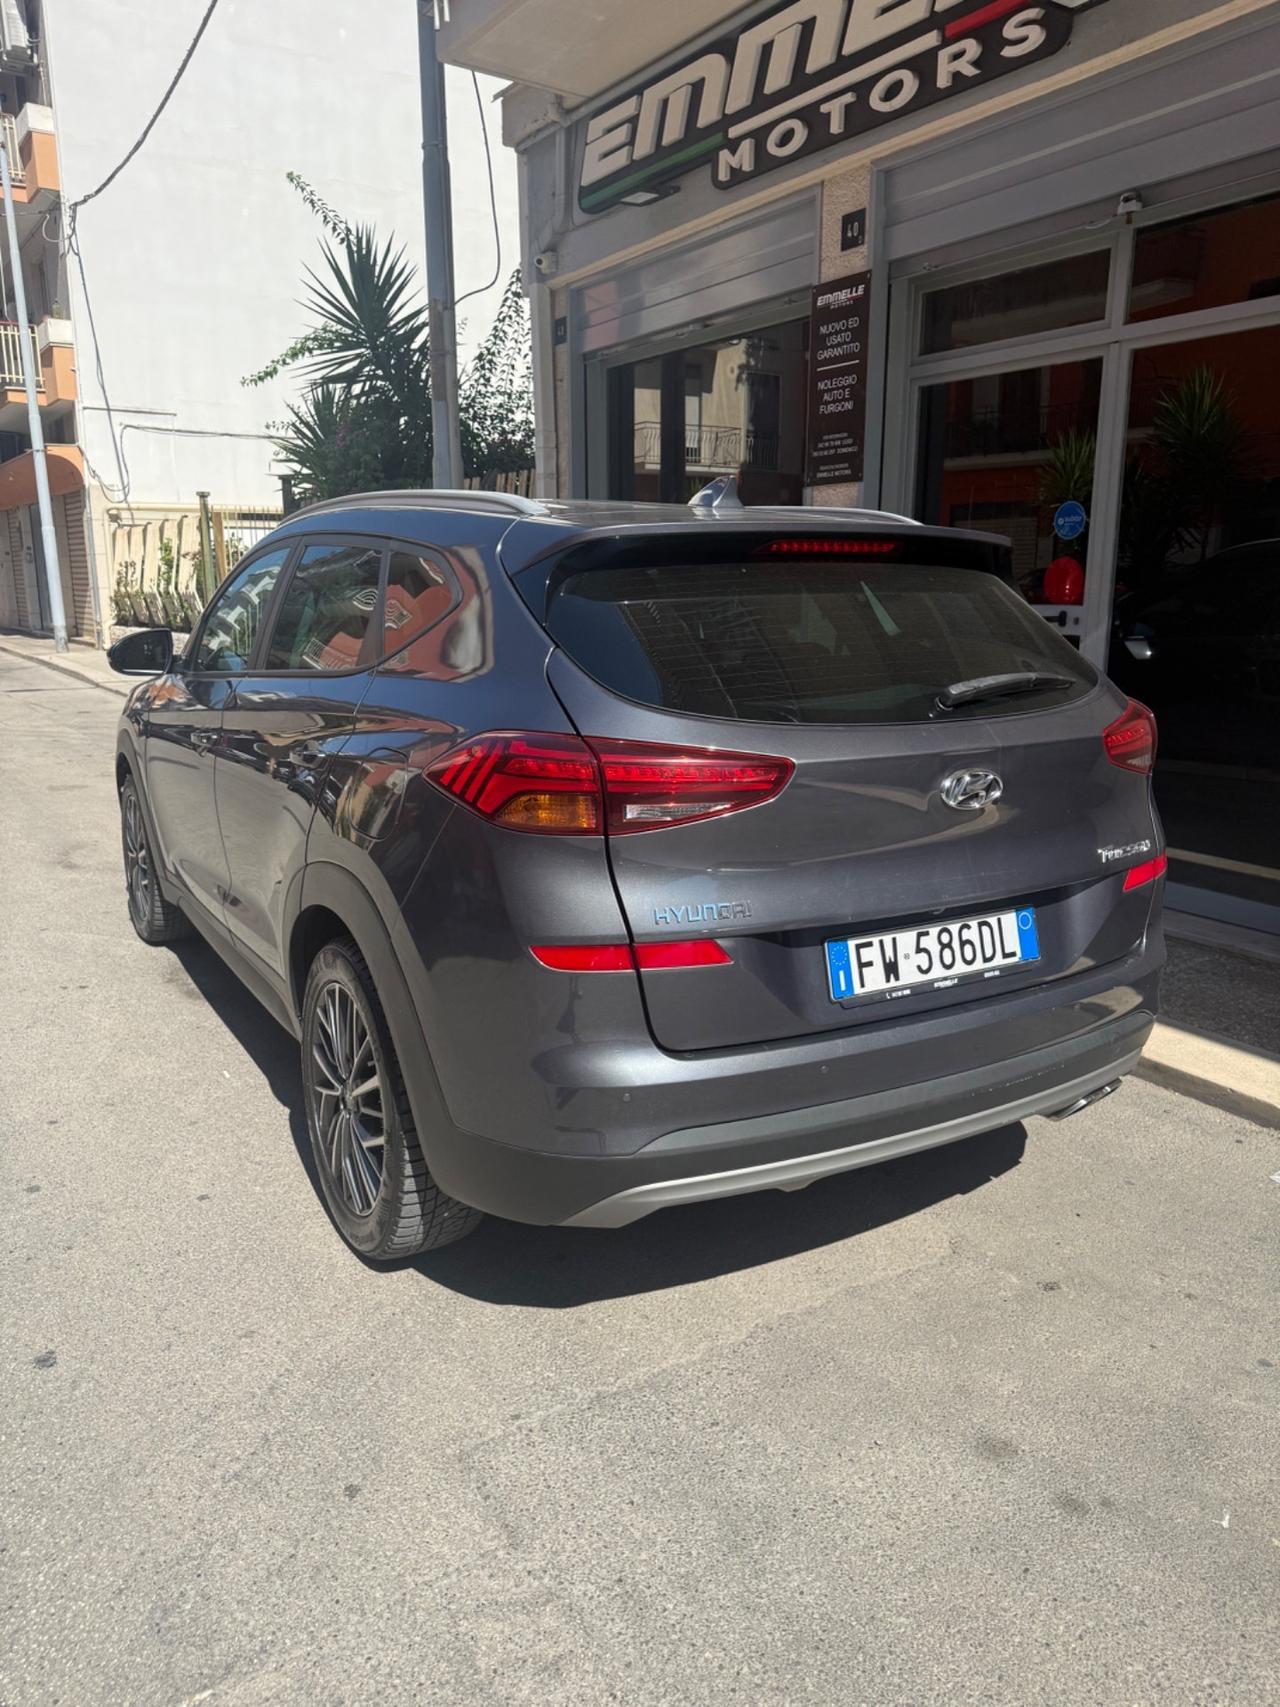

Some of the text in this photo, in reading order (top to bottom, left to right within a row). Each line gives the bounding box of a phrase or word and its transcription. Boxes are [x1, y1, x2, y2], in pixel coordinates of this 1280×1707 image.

[717, 7, 1048, 182] MOTORS
[816, 284, 865, 306] EMMELLE
[819, 317, 860, 335] NUOVO ED
[825, 331, 852, 346] USATO
[817, 342, 861, 361] GARANTITO
[818, 374, 858, 390] NOLEGGIO
[822, 388, 851, 402] AUTO E
[819, 400, 854, 415] FURGONI
[654, 900, 752, 925] HYUNDAI
[854, 917, 1018, 989] FW 586DL
